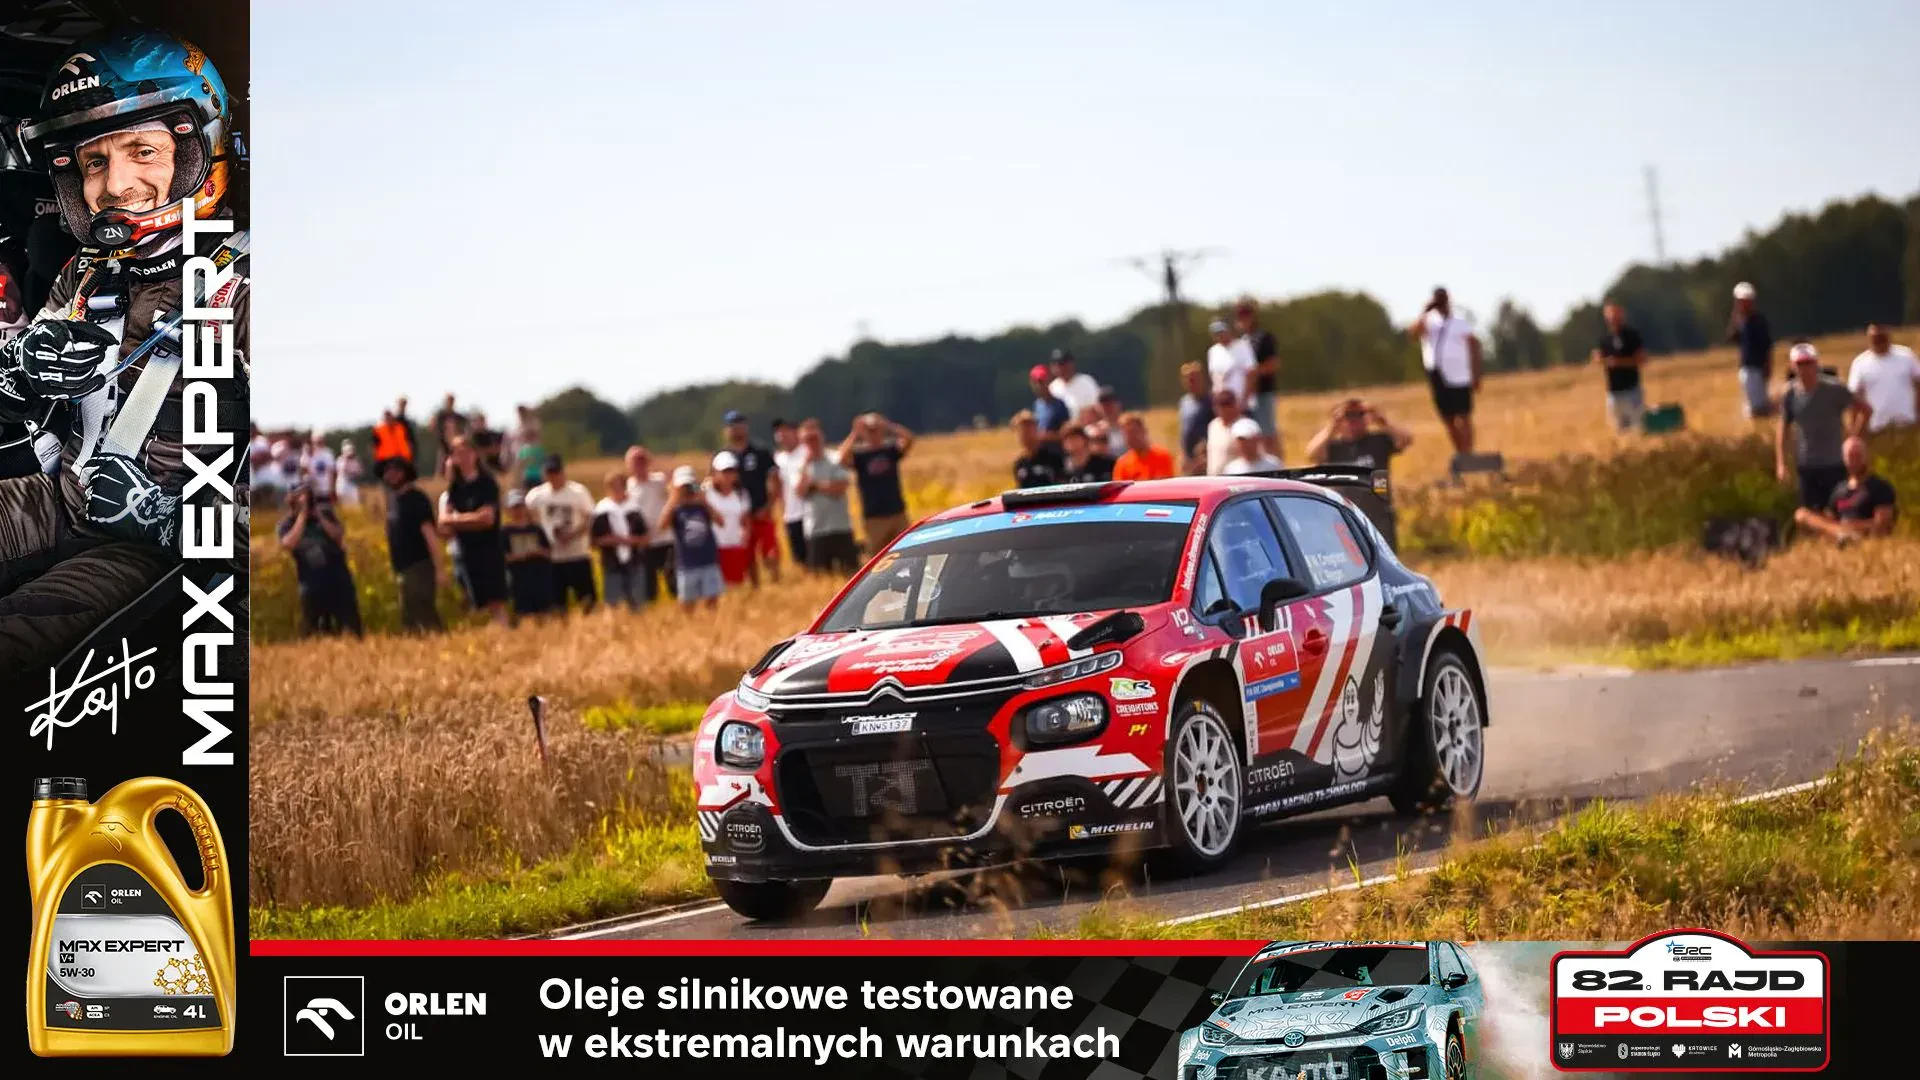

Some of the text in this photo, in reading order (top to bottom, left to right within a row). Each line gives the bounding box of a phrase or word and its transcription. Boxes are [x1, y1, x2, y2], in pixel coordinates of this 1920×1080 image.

[52, 75, 100, 101] ORLEN
[143, 258, 177, 276] ORLEN
[1091, 821, 1154, 834] MICHELIN
[111, 889, 142, 897] ORLEN
[60, 940, 185, 952] MAX EXPERT
[60, 967, 95, 978] 5W-30
[1248, 1001, 1361, 1016] MAX EXPERT
[1387, 1033, 1418, 1046] Delphi
